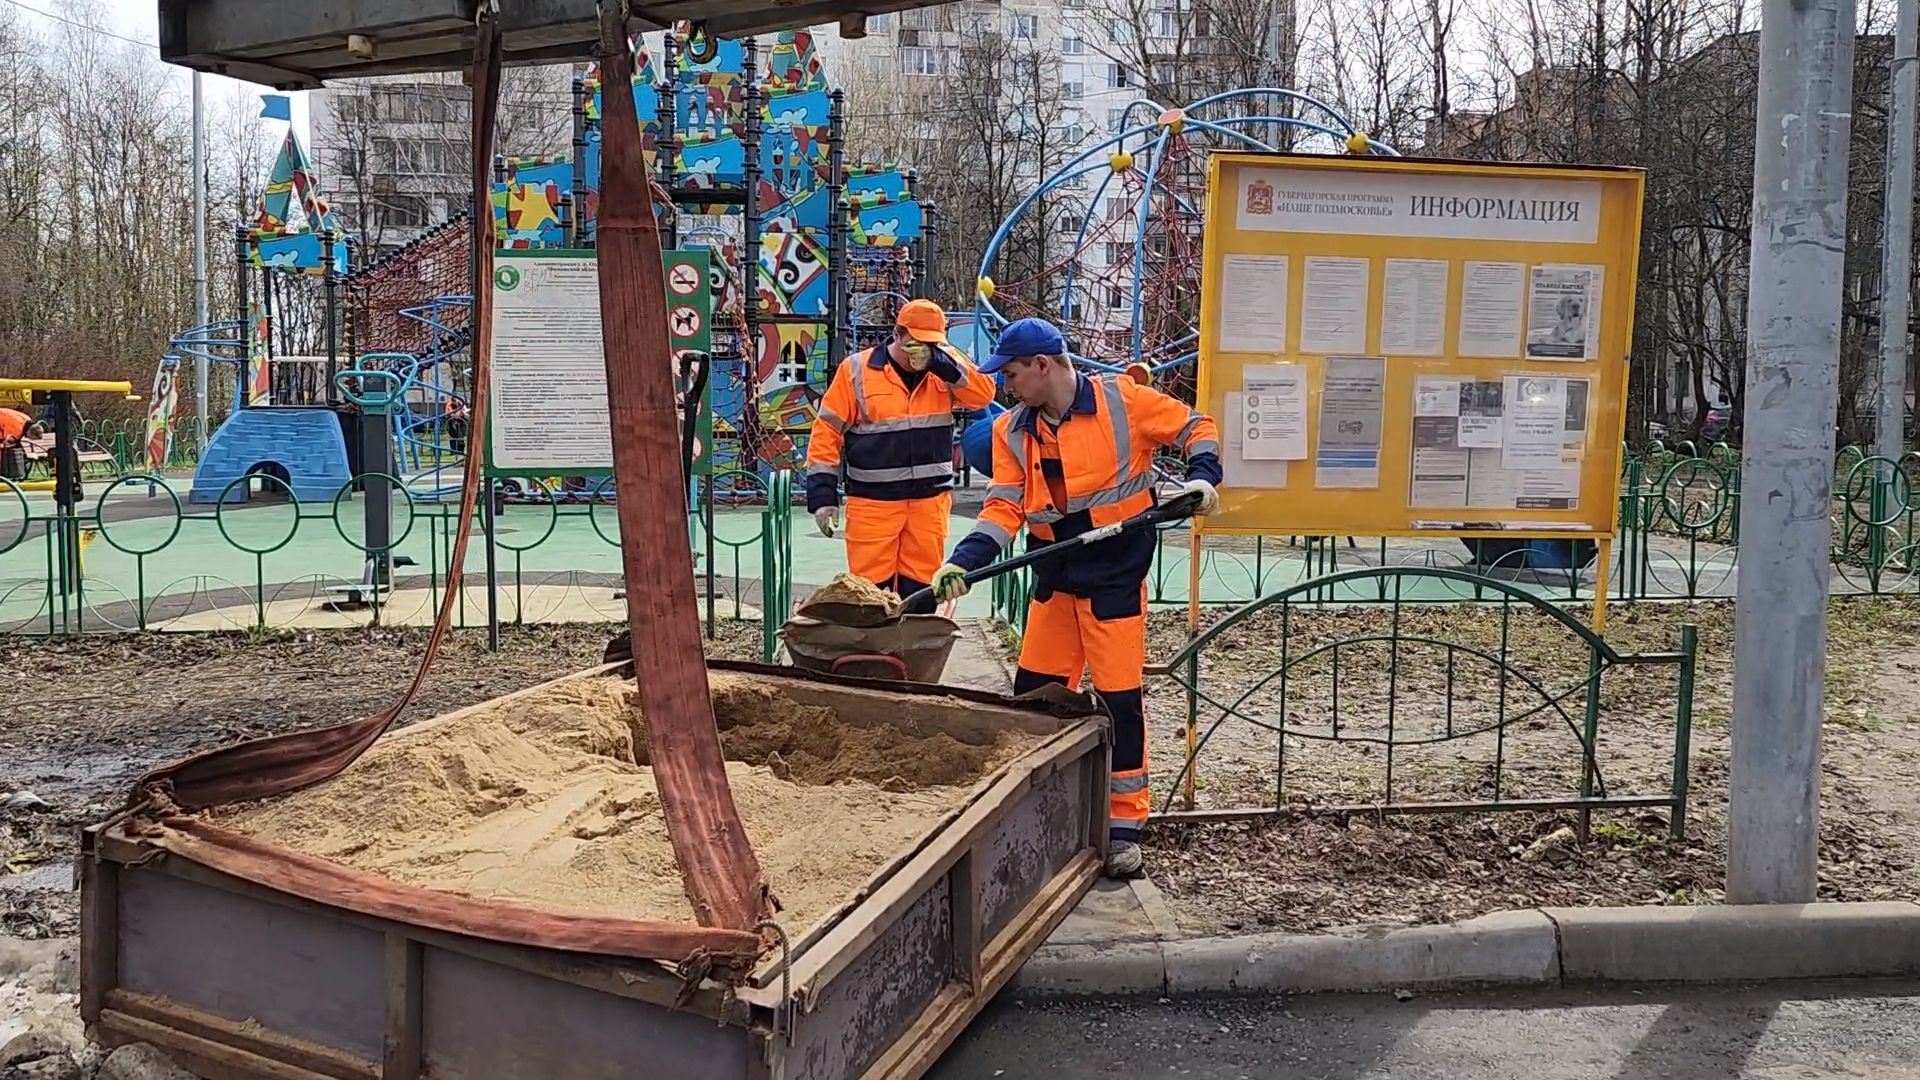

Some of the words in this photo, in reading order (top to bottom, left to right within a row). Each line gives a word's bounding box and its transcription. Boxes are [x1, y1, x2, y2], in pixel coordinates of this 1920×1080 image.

[1277, 190, 1347, 201] ГУБЕРНАТОРСКАЯ
[1348, 192, 1394, 203] ПРОГРАММА
[1277, 203, 1312, 213] «НАШЕ
[1314, 204, 1393, 216] ПОДМОСКОВЬЕ»
[1409, 195, 1581, 224] ИНФОРМАЦИЯ
